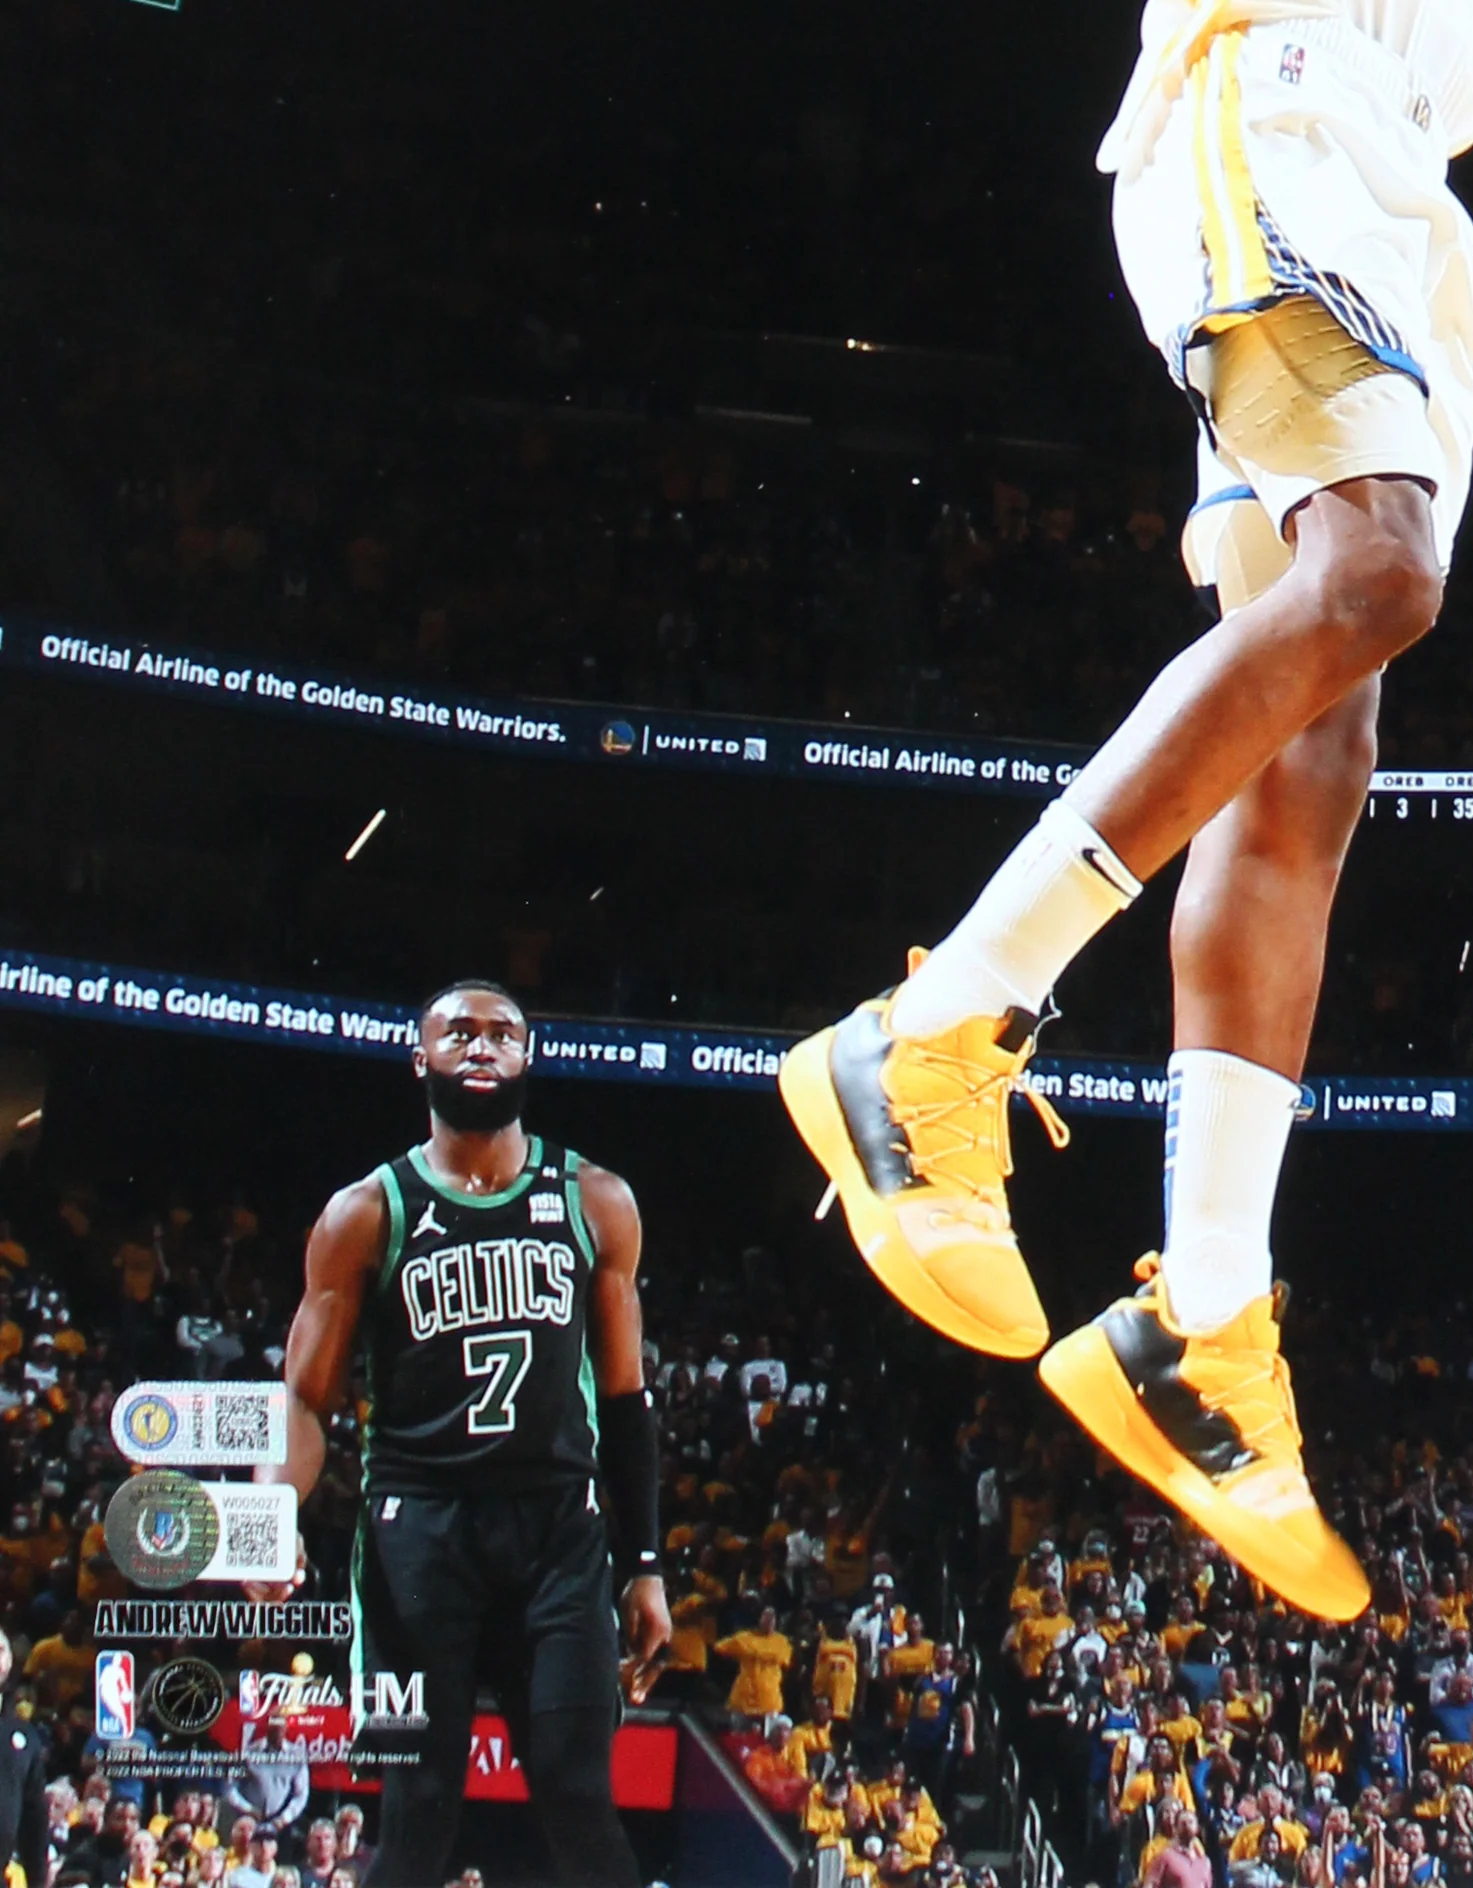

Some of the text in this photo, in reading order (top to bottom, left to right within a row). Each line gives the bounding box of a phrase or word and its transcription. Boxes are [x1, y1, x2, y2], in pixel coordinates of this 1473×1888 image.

[42, 636, 565, 742] Official Airline of the Golden State Warriors.
[656, 735, 739, 753] UNITED
[805, 742, 889, 769] Official
[895, 750, 975, 776] Airline
[981, 758, 1006, 779] of
[1012, 760, 1050, 783] the
[1383, 776, 1424, 787] OREB
[1397, 797, 1408, 818] 3
[78, 977, 109, 1002] of
[115, 981, 160, 1010] the
[166, 988, 259, 1024] Golden
[266, 1002, 334, 1034] State
[543, 1041, 636, 1061] UNITED
[1069, 1073, 1135, 1104] State
[1338, 1096, 1426, 1111] UNITED
[401, 1238, 575, 1342] CELTICS
[463, 1330, 533, 1434] 7
